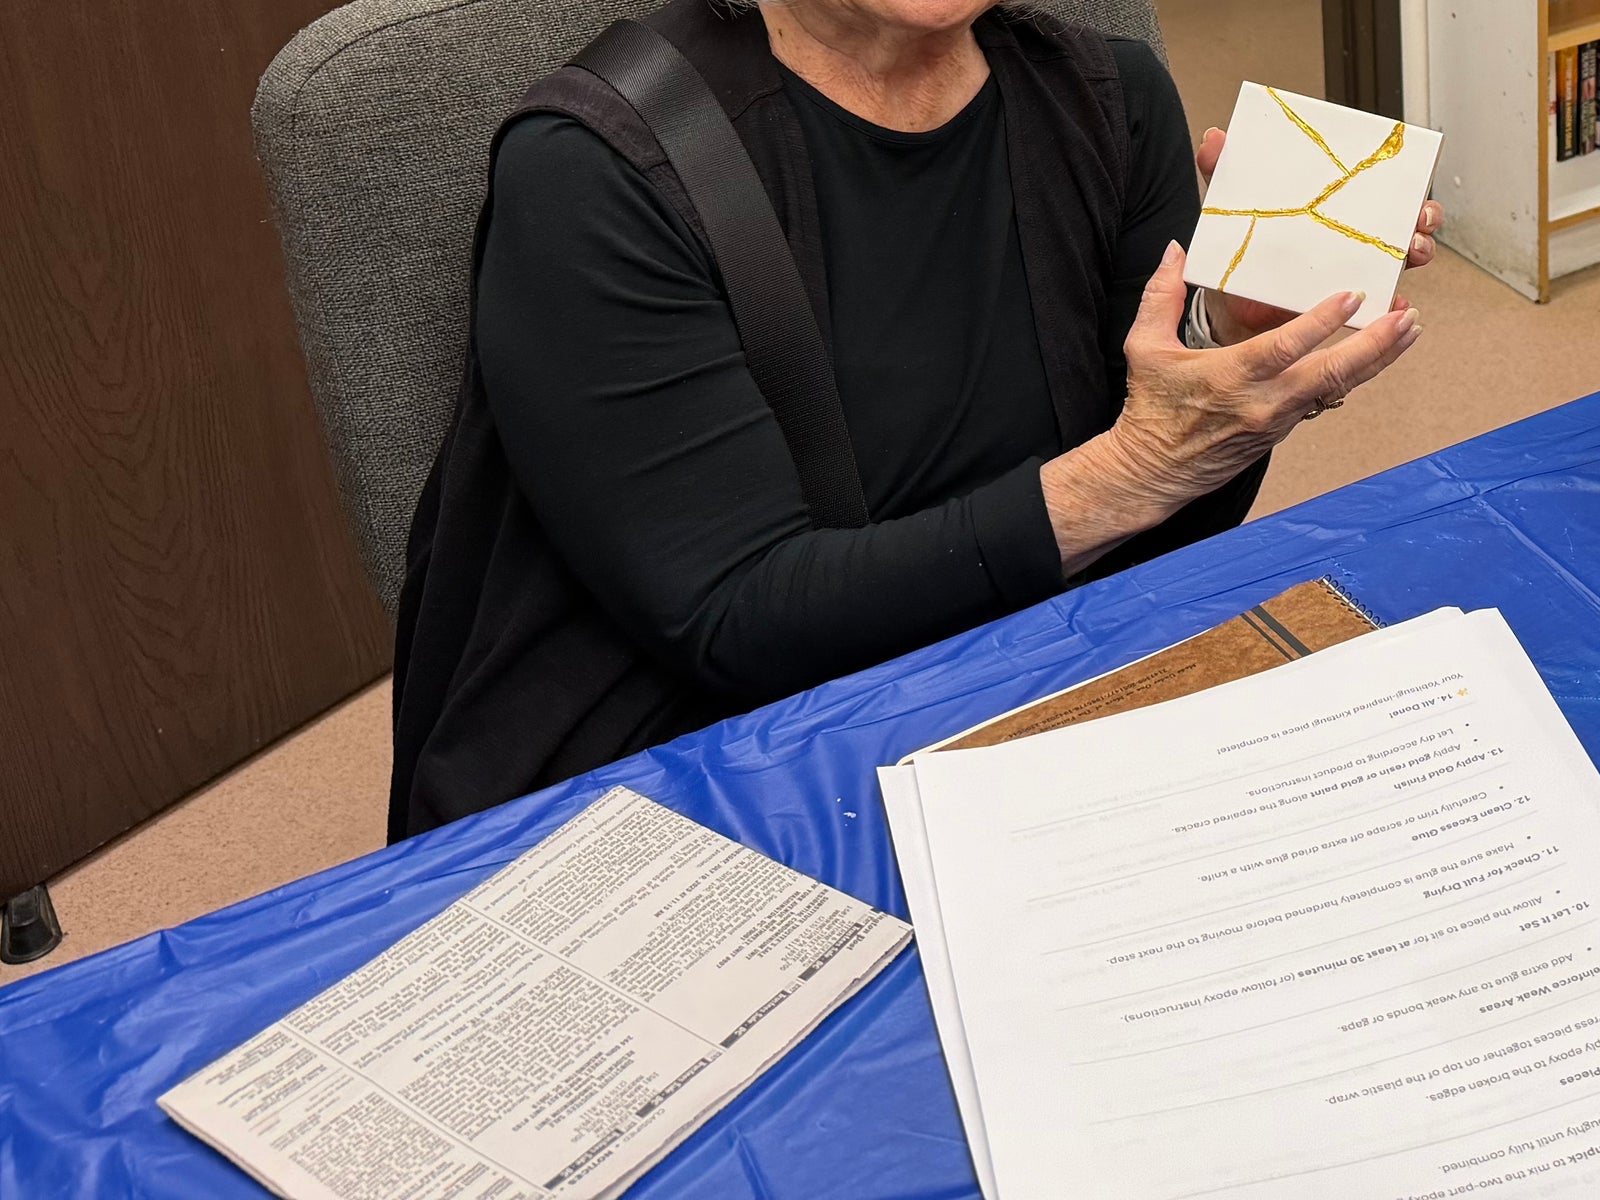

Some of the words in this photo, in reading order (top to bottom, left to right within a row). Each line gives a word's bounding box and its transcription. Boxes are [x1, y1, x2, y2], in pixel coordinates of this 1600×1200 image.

[1441, 673, 1464, 684] Your
[1352, 680, 1441, 715] Yobitsugi-inspired
[1421, 698, 1435, 708] All
[1437, 693, 1453, 702] 14.
[1389, 703, 1421, 719] Done!
[1311, 709, 1352, 728] Kintsugi
[1281, 722, 1311, 736] piece
[1217, 735, 1269, 755] complete!
[1487, 747, 1504, 757] 13.
[1455, 753, 1485, 769] Apply
[1427, 765, 1455, 779] Gold
[1393, 774, 1427, 790] Finish
[796, 895, 828, 923] SUBSTITUTE
[1513, 895, 1543, 912] Allow
[1571, 901, 1590, 911] 10.
[1492, 907, 1512, 919] the
[1540, 915, 1551, 924] It
[1551, 907, 1571, 920] Let
[1459, 913, 1491, 929] piece
[1519, 919, 1541, 932] Set
[1429, 929, 1445, 940] sit
[1445, 925, 1459, 934] to
[846, 934, 865, 952] Post
[1397, 939, 1411, 949] at
[1413, 935, 1429, 945] for
[757, 945, 772, 959] SALE
[1365, 944, 1398, 959] least
[1349, 953, 1365, 965] 30
[1297, 959, 1348, 978] minutes
[1279, 972, 1296, 983] (or
[1241, 979, 1277, 993] follow
[1203, 989, 1239, 1003] epoxy
[1120, 998, 1202, 1023] instructions).
[1533, 1024, 1573, 1045] pieces
[1483, 1039, 1533, 1062] together
[1441, 1061, 1464, 1074] top
[1463, 1056, 1481, 1067] on
[1405, 1073, 1427, 1085] the
[1427, 1069, 1441, 1080] of
[1361, 1077, 1404, 1097] plastic
[1325, 1091, 1361, 1105] wrap.
[1535, 1131, 1565, 1148] until
[1507, 1141, 1535, 1155] fully
[568, 1149, 612, 1187] NOTICES
[1437, 1149, 1506, 1174] combined.
